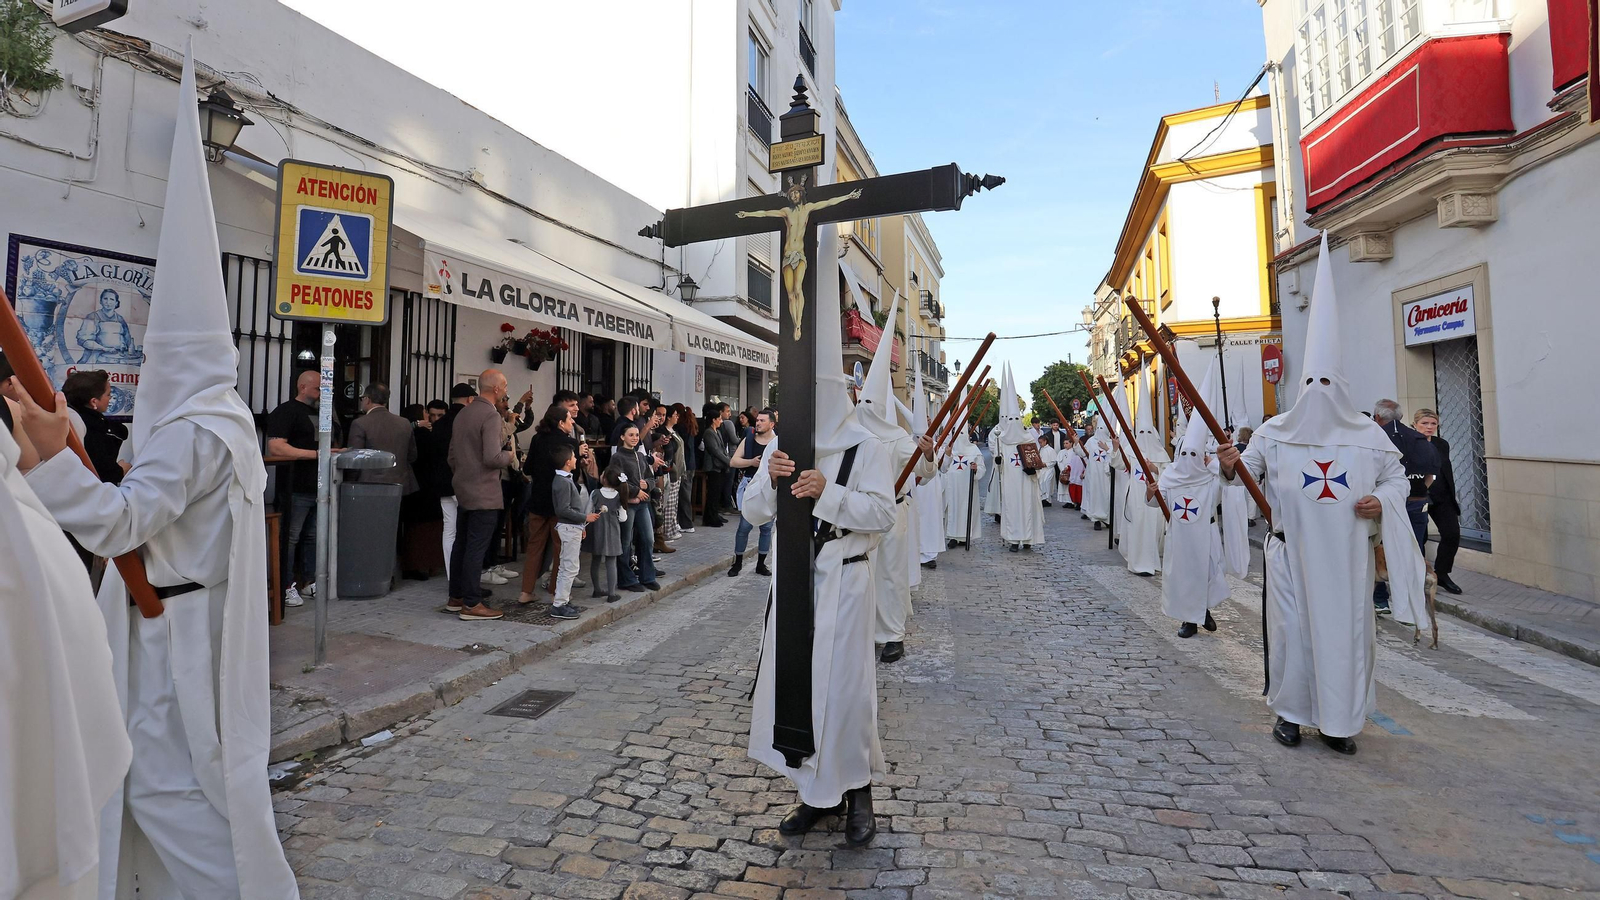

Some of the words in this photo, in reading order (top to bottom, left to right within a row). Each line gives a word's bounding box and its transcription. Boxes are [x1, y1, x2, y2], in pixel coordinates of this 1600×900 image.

[297, 177, 377, 205] ATENCIÓN
[72, 265, 100, 281] LA
[101, 264, 154, 293] GLORIA
[291, 284, 373, 310] PEATONES
[461, 272, 495, 302] LA
[499, 284, 579, 322] GLORIA
[583, 306, 655, 341] TABERNA
[1408, 296, 1468, 327] Carnicería
[687, 333, 701, 349] LA
[702, 337, 736, 357] GLORIA
[737, 346, 770, 365] TABERNA
